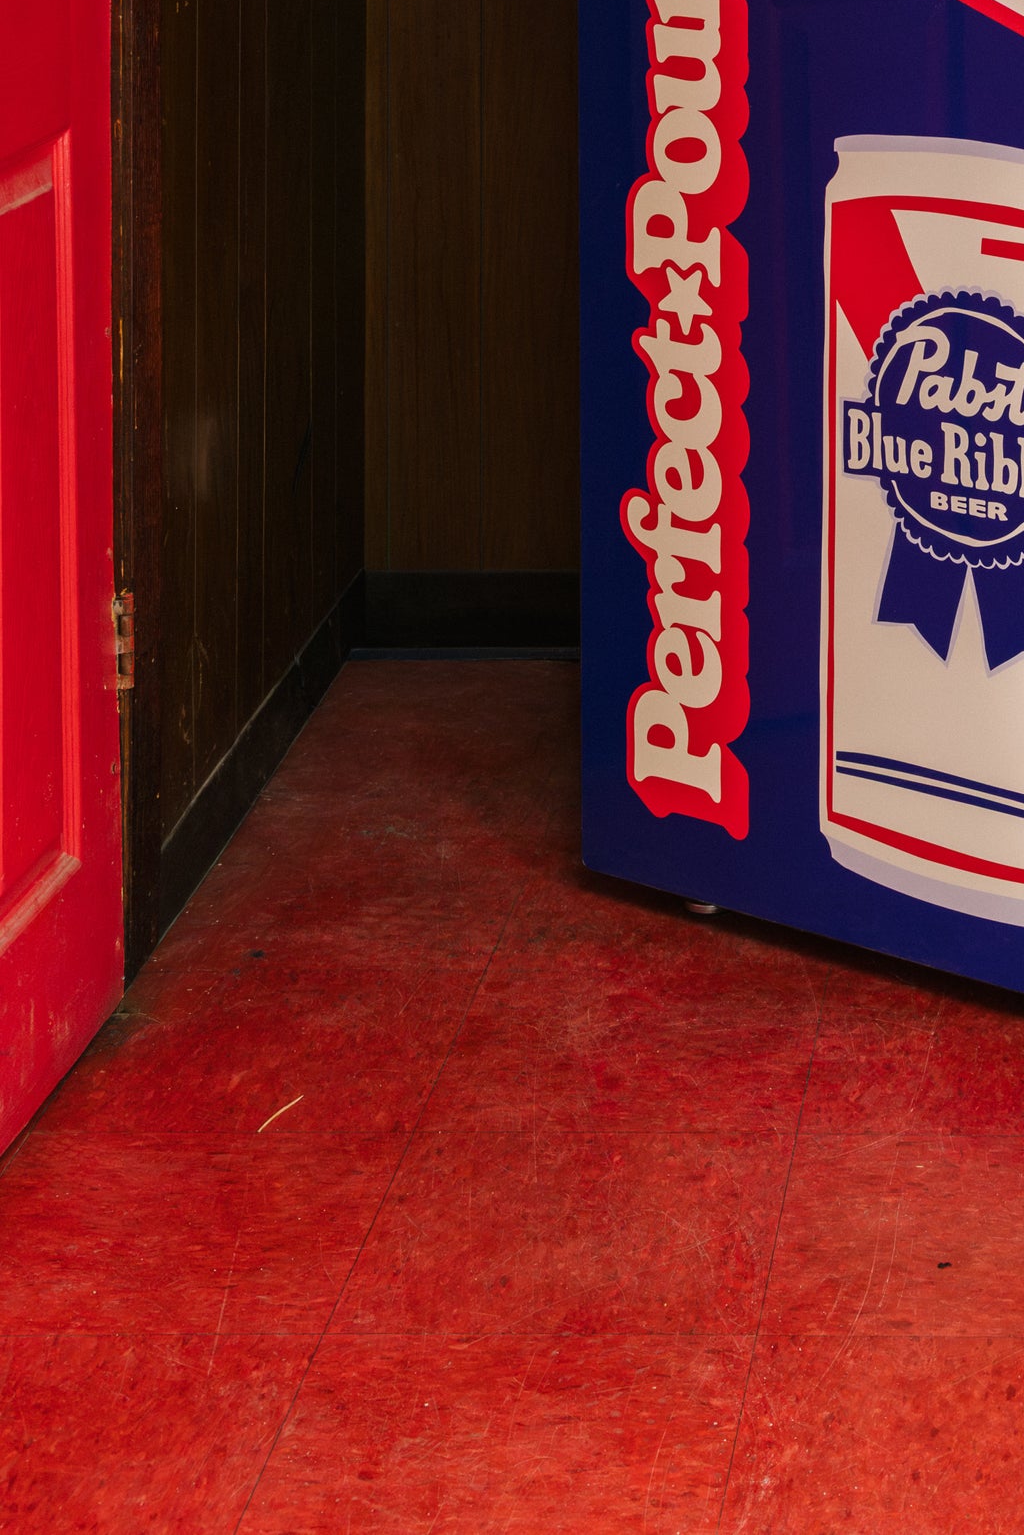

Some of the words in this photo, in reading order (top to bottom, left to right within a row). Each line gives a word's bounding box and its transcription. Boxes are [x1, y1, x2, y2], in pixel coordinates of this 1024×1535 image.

[847, 408, 934, 477] Blue
[930, 492, 1008, 521] BEER
[620, 312, 723, 805] Perfect
